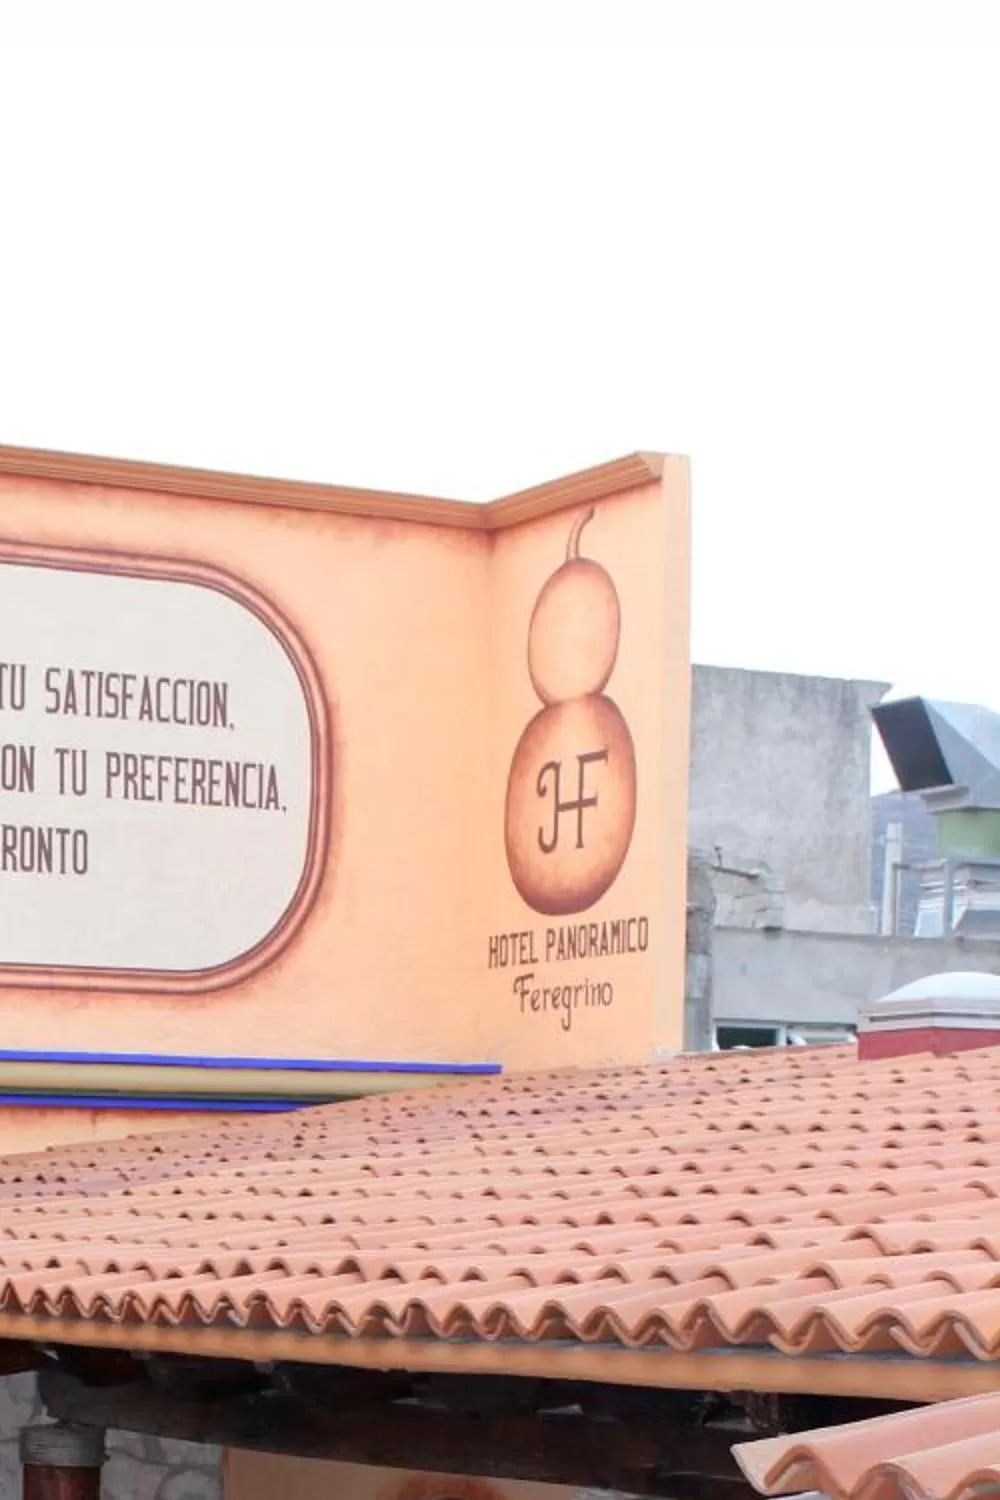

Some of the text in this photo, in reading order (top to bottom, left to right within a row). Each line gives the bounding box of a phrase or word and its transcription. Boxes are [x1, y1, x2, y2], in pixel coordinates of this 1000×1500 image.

[44, 667, 235, 731] SATISFACCION.
[53, 747, 88, 797] TU
[105, 751, 288, 813] PREFERENCIA.
[488, 916, 649, 969] HOTEL PANORAMICO
[513, 972, 614, 1032] Feregrino
